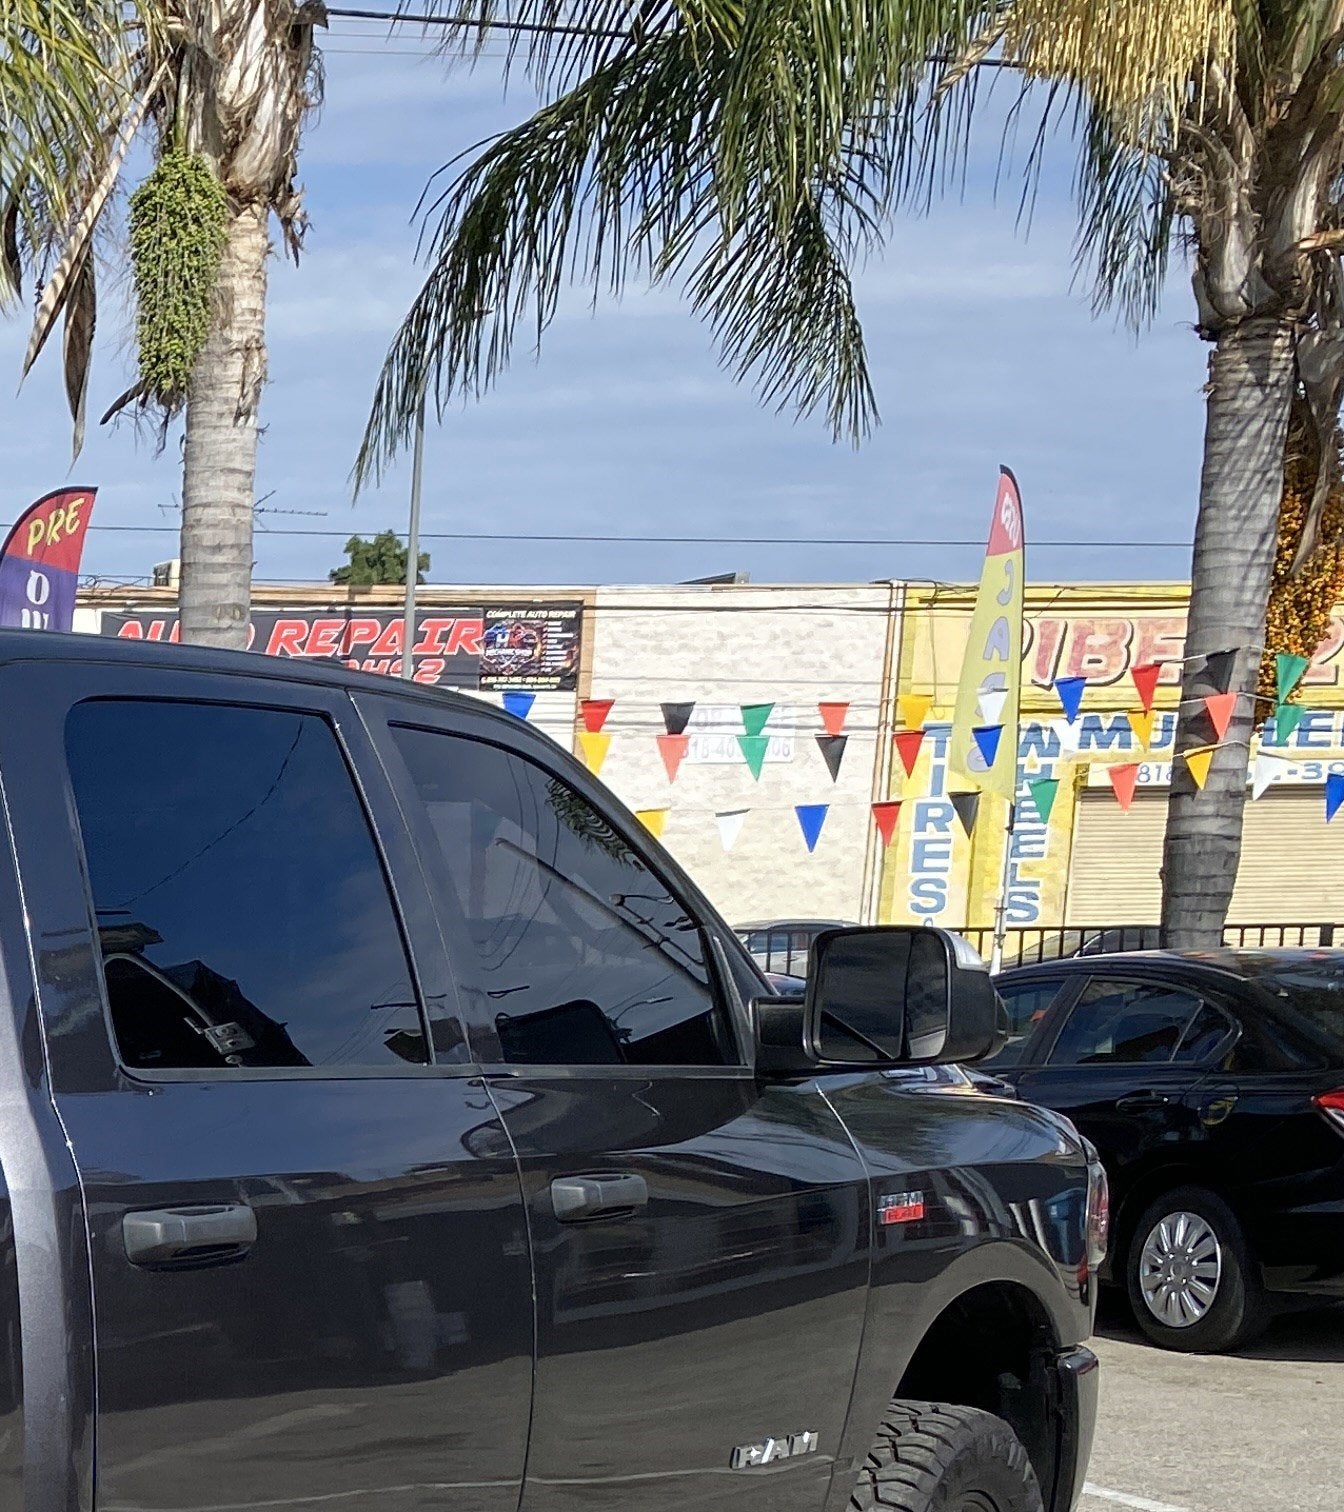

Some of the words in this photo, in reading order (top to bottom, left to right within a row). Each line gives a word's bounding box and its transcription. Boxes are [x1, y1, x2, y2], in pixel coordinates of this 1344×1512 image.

[27, 497, 85, 556] PRE
[266, 617, 486, 657] REPAIR
[910, 722, 955, 915] TIRES
[730, 1430, 819, 1470] RAM
